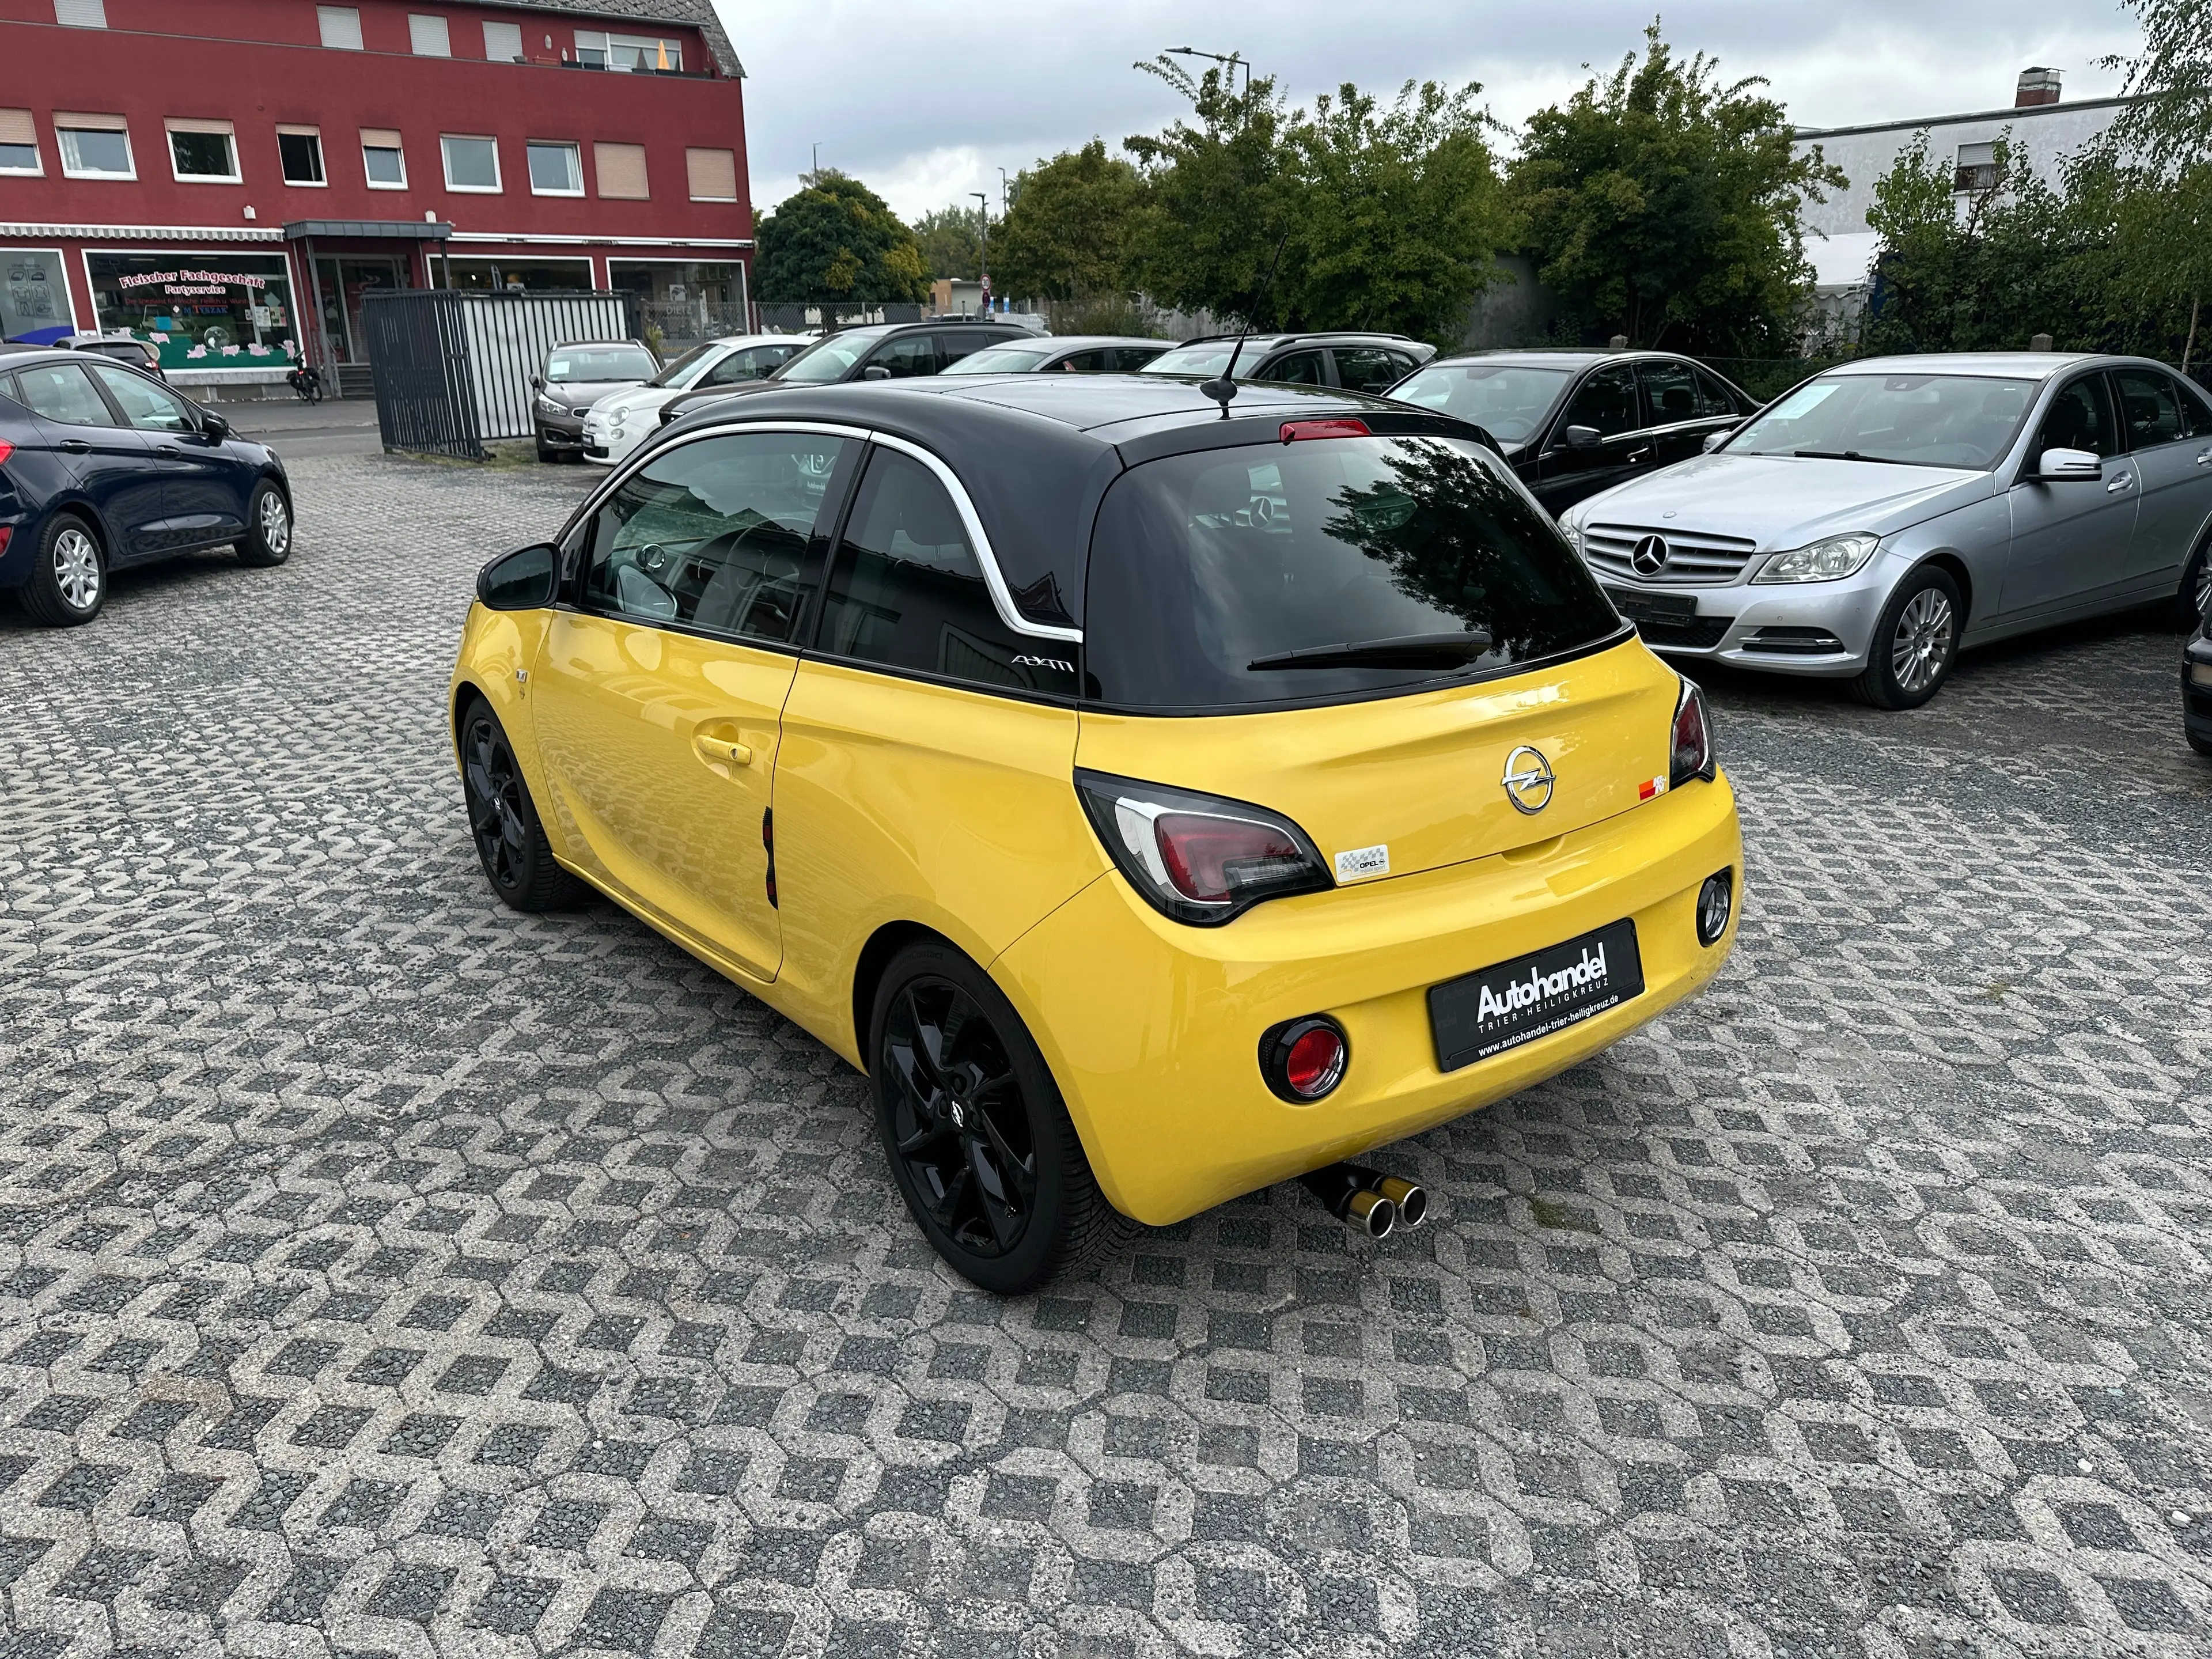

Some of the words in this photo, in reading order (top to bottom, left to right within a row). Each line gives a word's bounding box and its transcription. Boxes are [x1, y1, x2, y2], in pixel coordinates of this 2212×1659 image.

[119, 271, 177, 289] Fleischer
[180, 270, 265, 289] Fachgeschäft
[165, 285, 225, 296] Partyservice
[1359, 861, 1379, 869] OPEL
[1476, 942, 1607, 1023] Autohandel
[1478, 994, 1619, 1057] www.autohandel-trier-heiligkreuz.de
